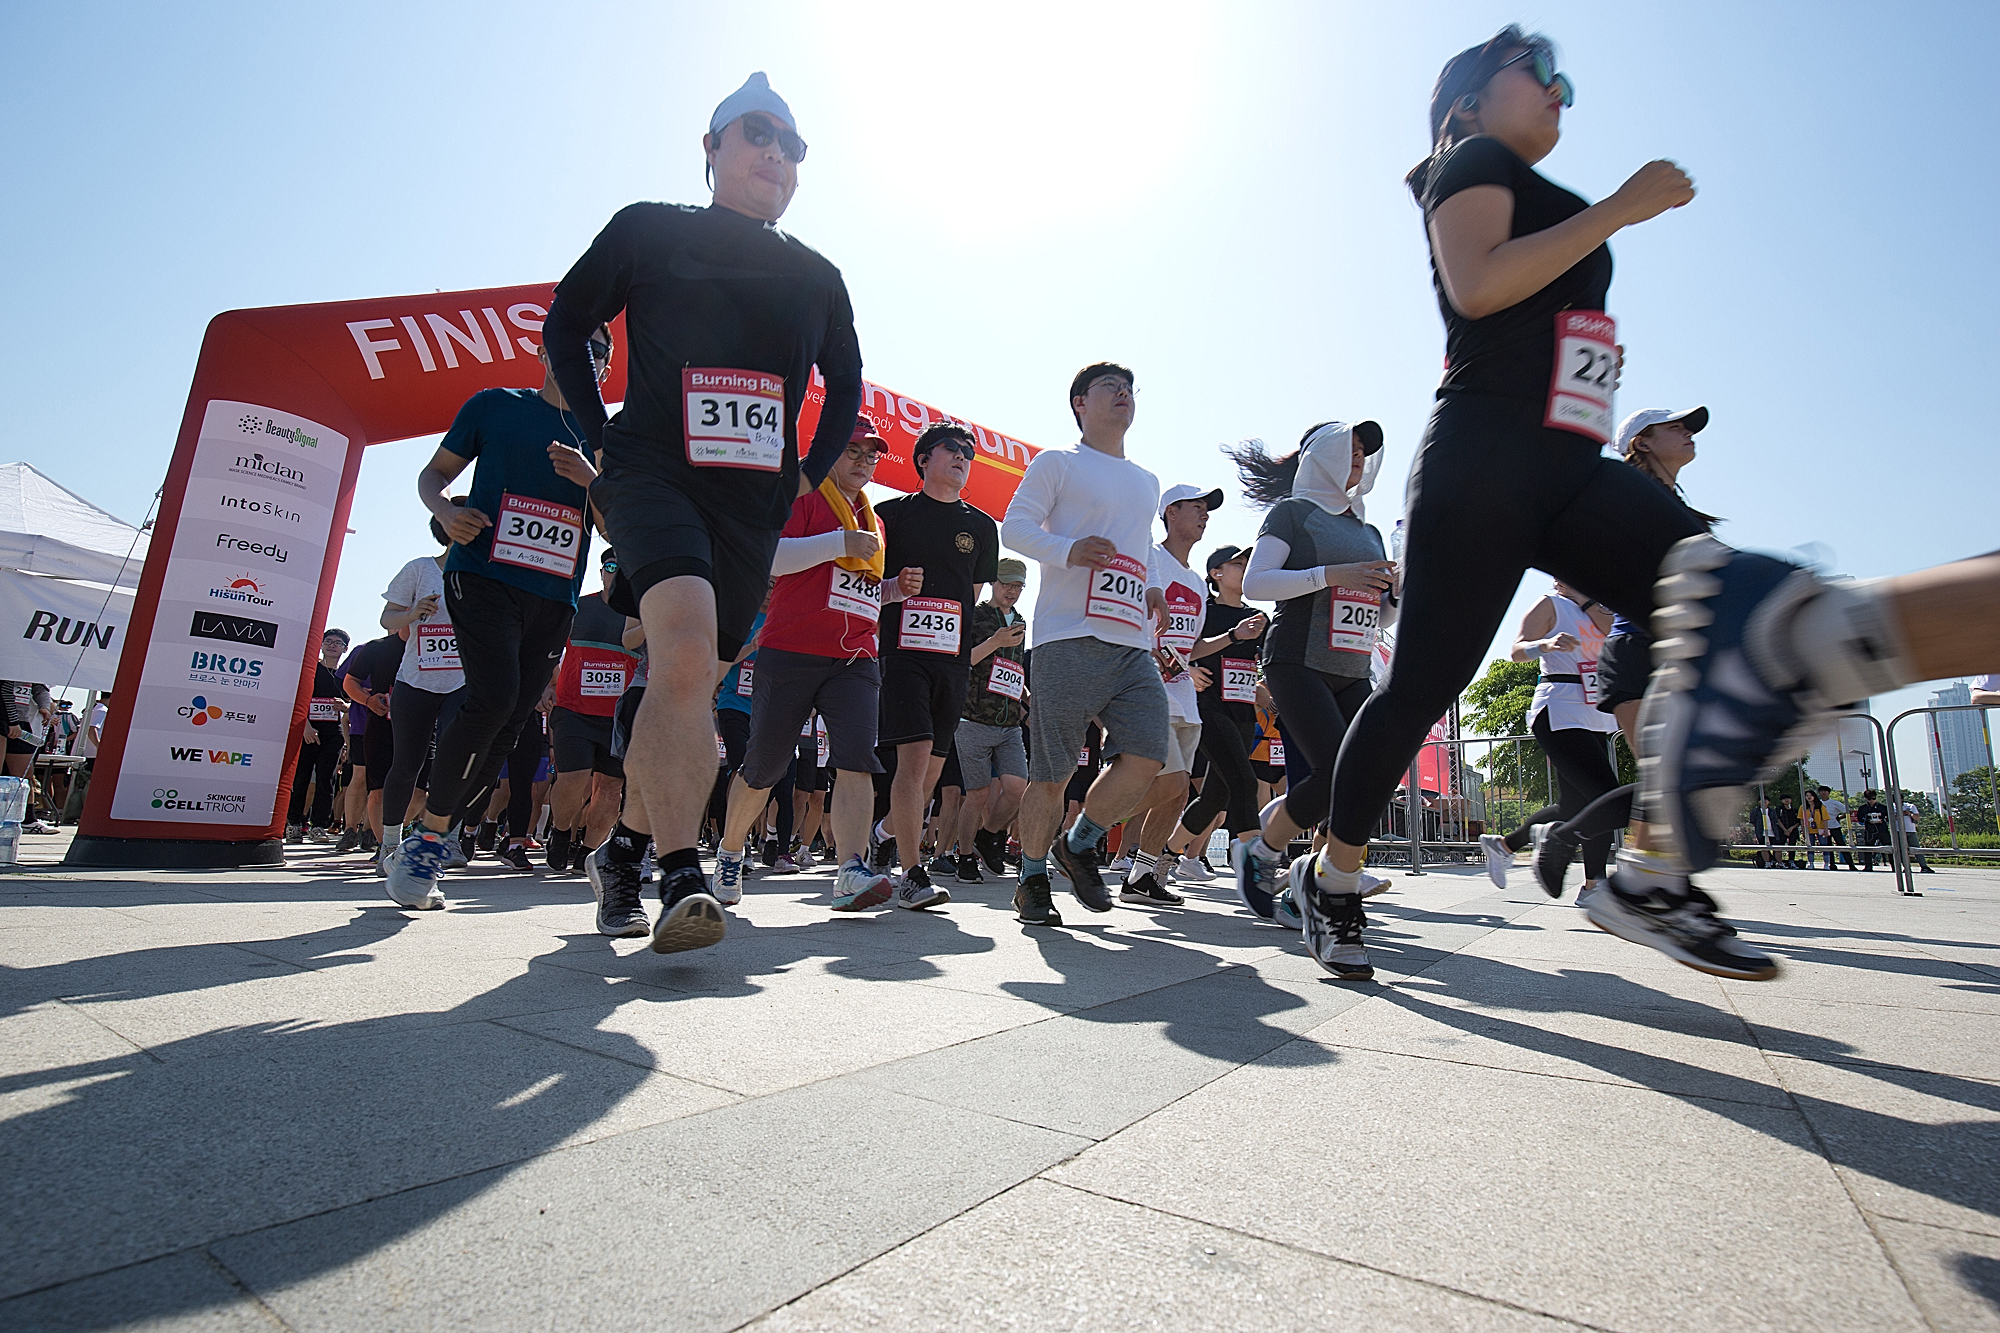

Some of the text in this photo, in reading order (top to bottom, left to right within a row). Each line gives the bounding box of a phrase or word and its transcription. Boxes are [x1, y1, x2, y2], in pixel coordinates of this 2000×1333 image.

[345, 302, 551, 380] FINIS
[692, 373, 782, 393] Burning Run
[701, 398, 778, 433] 3164
[265, 419, 319, 449] BeautySignal
[235, 453, 304, 483] miclan
[507, 497, 559, 517] Burning
[561, 509, 581, 523] Run
[508, 516, 574, 549] 3049
[216, 533, 288, 563] Freedy
[209, 588, 274, 607] HisunTour
[839, 572, 880, 603] 2488
[1100, 572, 1144, 603] 2018
[907, 599, 959, 610] Burning Run
[908, 613, 956, 632] 2436
[1341, 605, 1379, 629] 2053
[22, 609, 116, 650] RUN
[426, 638, 459, 652] 309
[191, 650, 264, 677] BROS
[1225, 660, 1250, 669] Burning
[188, 673, 260, 690] 브로스 눈 안마기
[585, 671, 621, 683] 3058
[995, 668, 1022, 686] 2004
[1228, 671, 1256, 687] 2275
[177, 706, 196, 719] CJ
[224, 711, 257, 724] 푸드빌
[170, 747, 253, 767] WE VAPE
[163, 799, 246, 813] CELLTRION
[206, 793, 247, 803] SKINCURE
